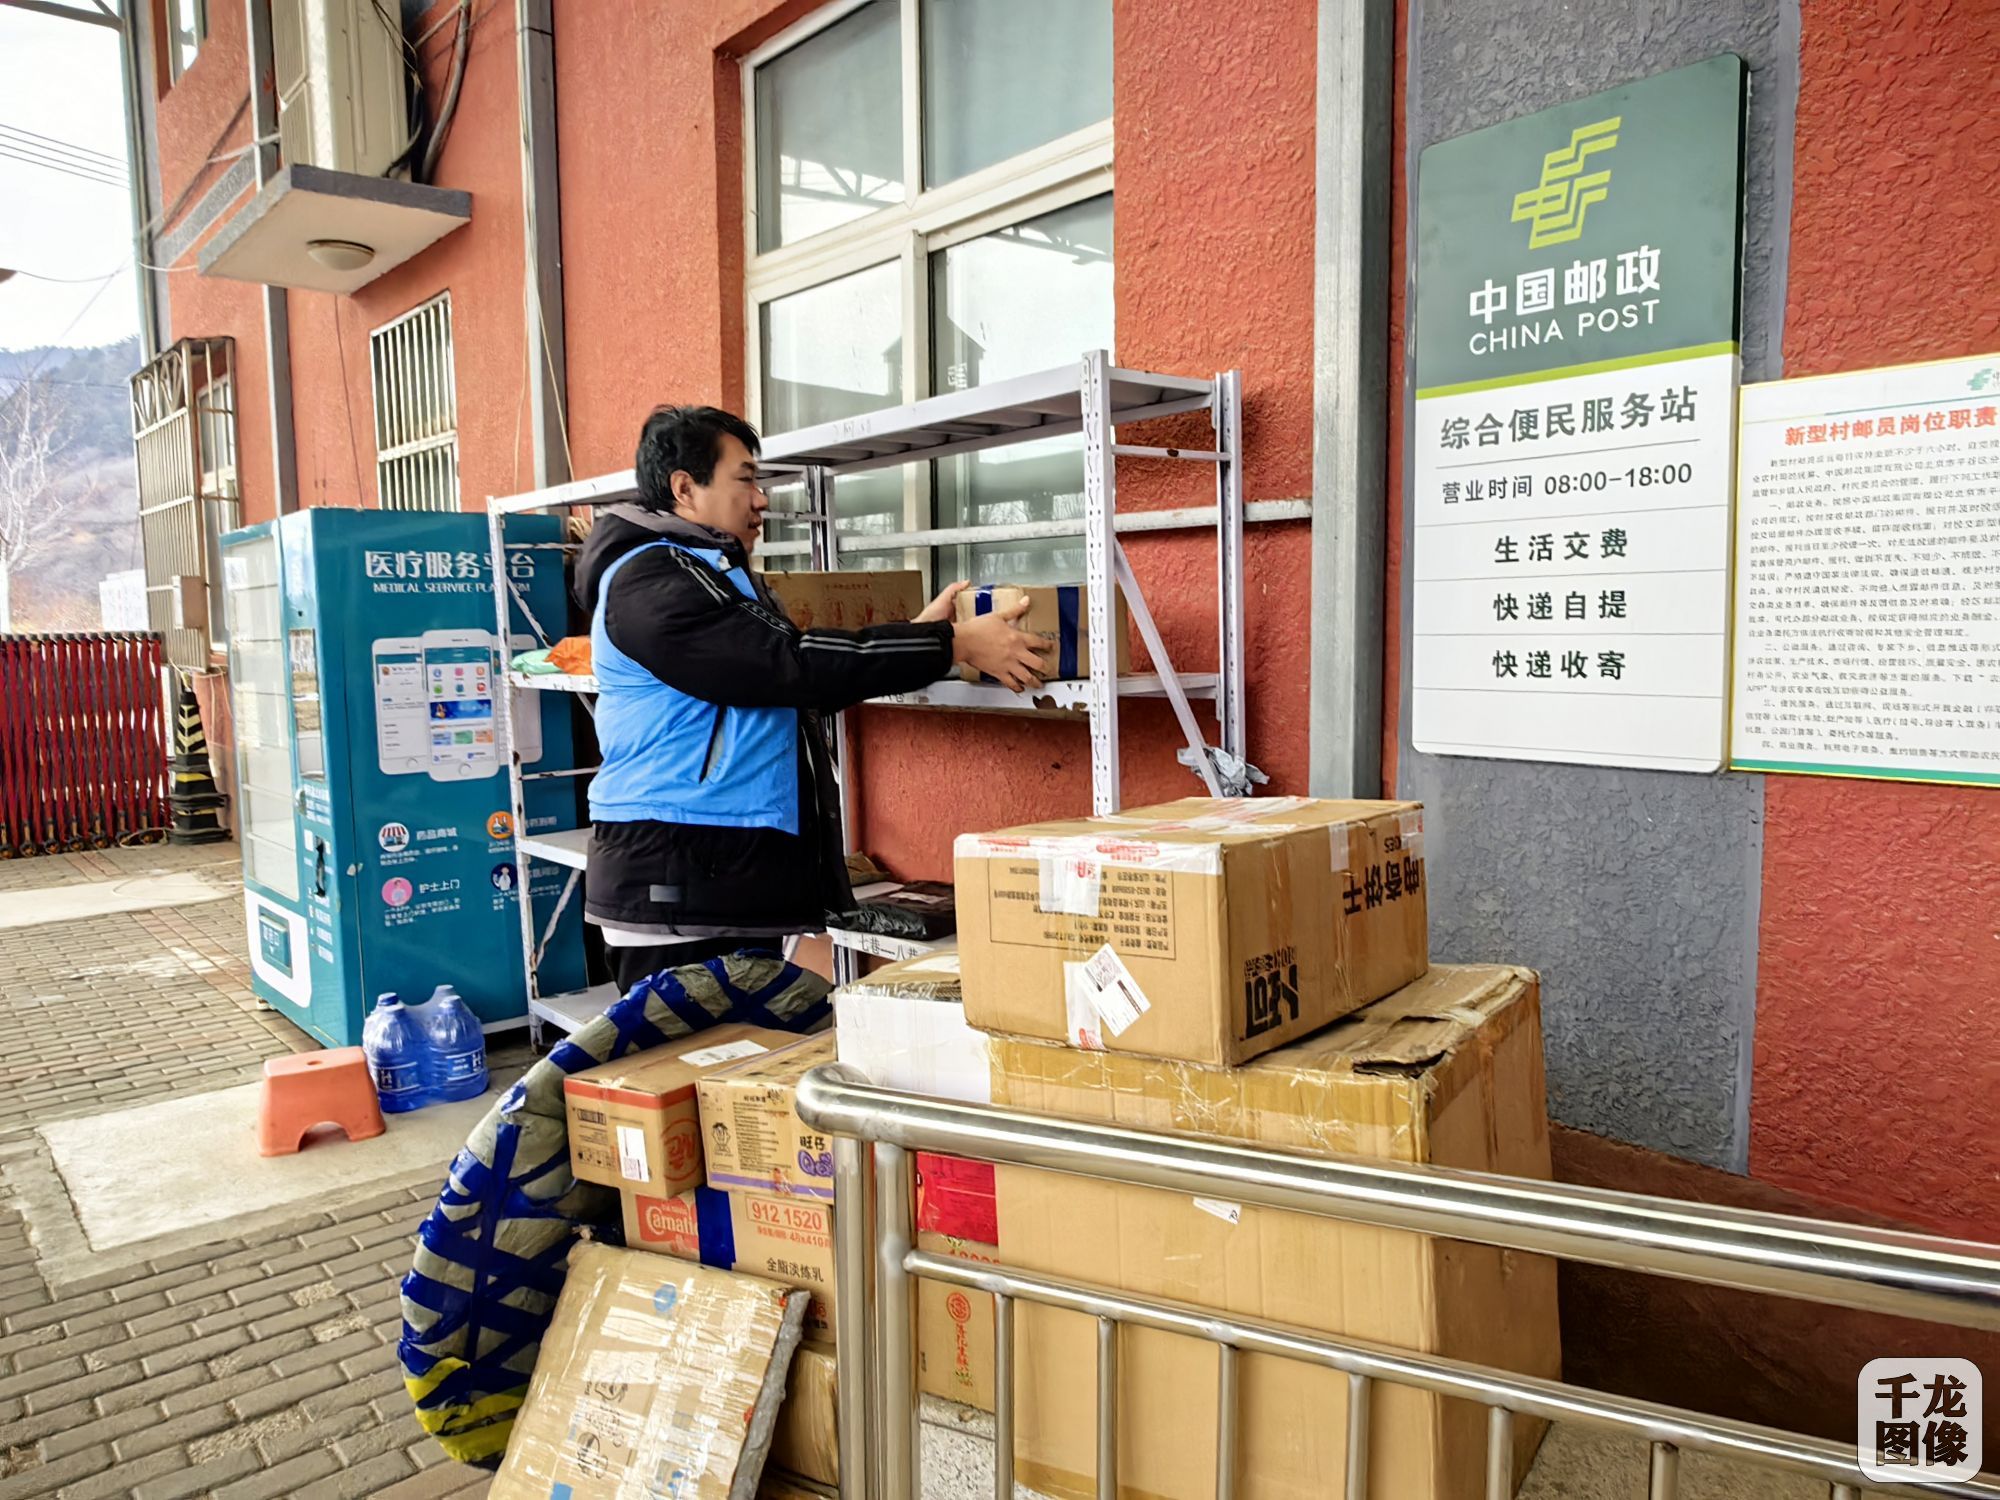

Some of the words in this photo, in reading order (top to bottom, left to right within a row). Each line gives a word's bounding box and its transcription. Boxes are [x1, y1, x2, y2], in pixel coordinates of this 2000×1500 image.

[1469, 245, 1661, 324] 中国邮政
[1469, 319, 1563, 355] CHINA
[1578, 299, 1660, 337] POST
[1440, 385, 1698, 450] 综合便民服务站
[1785, 406, 1998, 446] 新型村邮员岗位职责
[1442, 475, 1533, 504] 营业时间
[1544, 463, 1692, 495] 08:00-18:00
[1494, 528, 1628, 563] 生活交费
[373, 582, 421, 593] MEDICAL
[1493, 589, 1627, 621] 快递自提
[1492, 650, 1626, 680] 快递收寄
[751, 1202, 780, 1224] 912
[784, 1207, 822, 1231] 1520
[766, 1257, 824, 1282] 全脂淡炼乳
